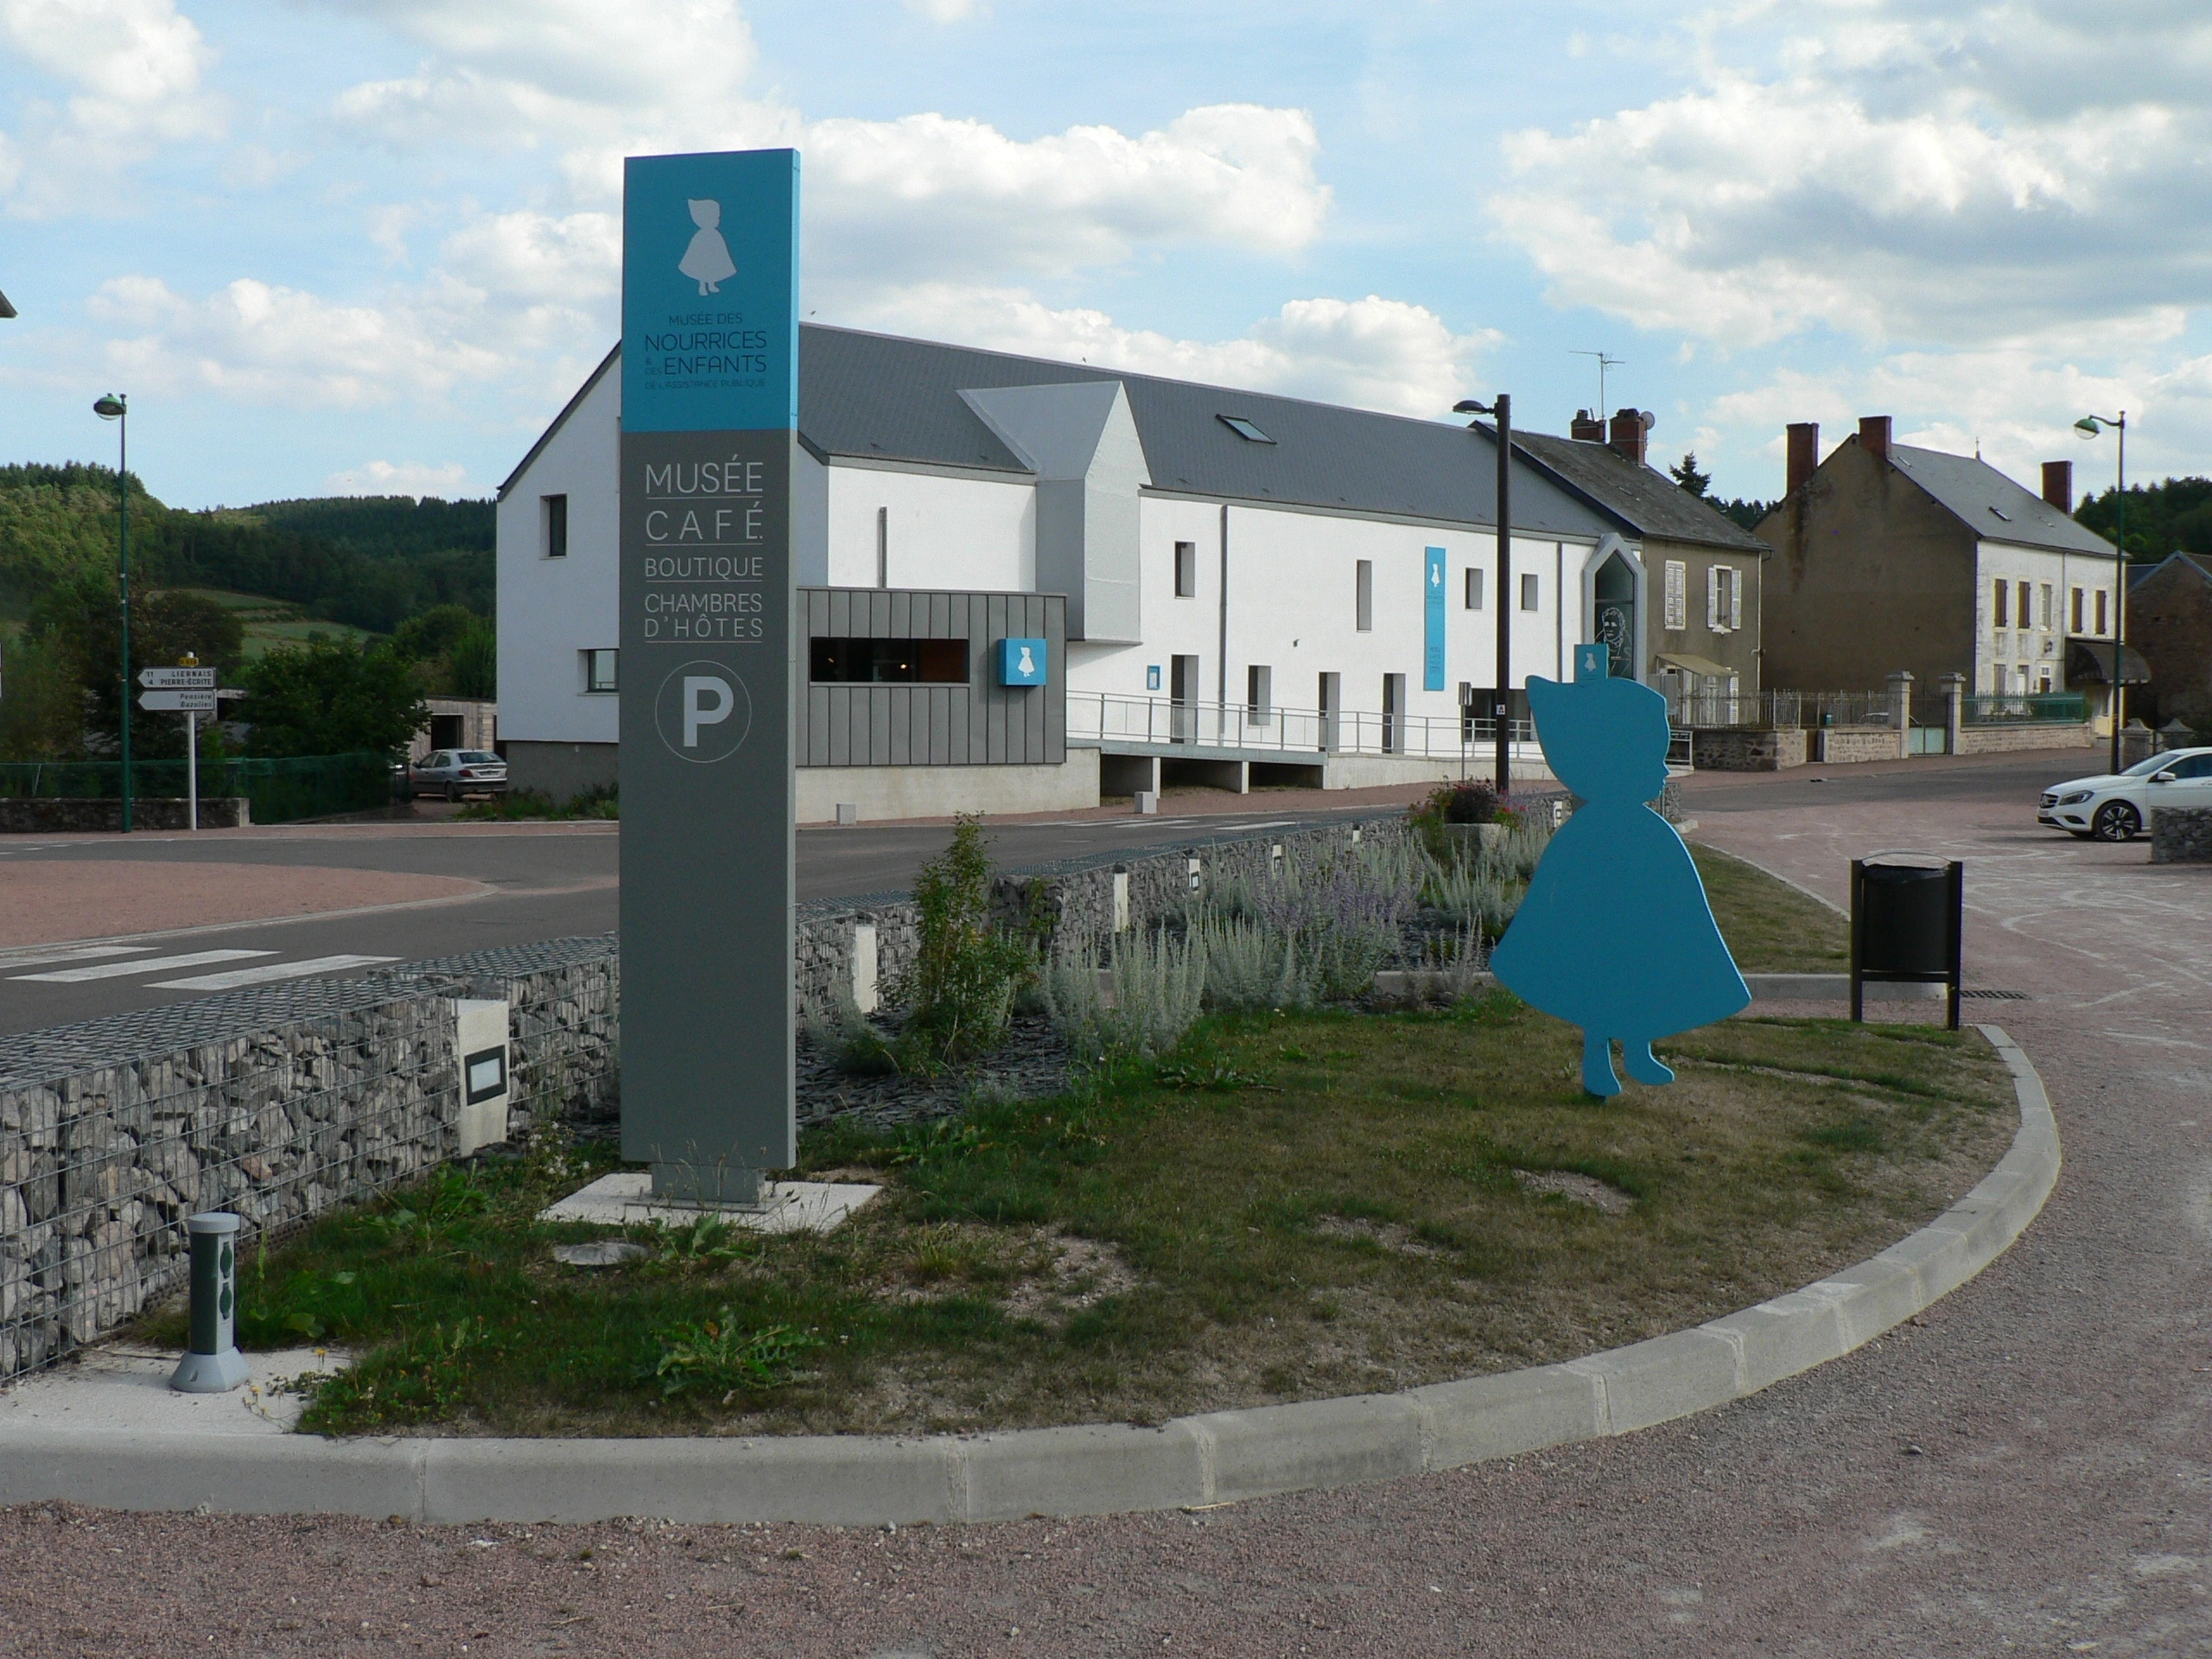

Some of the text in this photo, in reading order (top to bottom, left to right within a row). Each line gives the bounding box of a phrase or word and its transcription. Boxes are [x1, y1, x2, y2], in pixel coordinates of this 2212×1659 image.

[669, 311, 743, 326] MUSÉE DES
[645, 330, 767, 352] NOURRICES
[664, 354, 767, 375] ENFANTS
[721, 378, 766, 388] PUBLIQUE
[645, 454, 764, 493] MUSÉE
[645, 500, 764, 541] CAFÉ
[645, 557, 764, 580] BOUTIQUE
[645, 593, 762, 613] CHAMBRES
[644, 613, 763, 638] D'HÔTES
[683, 676, 734, 747] P
